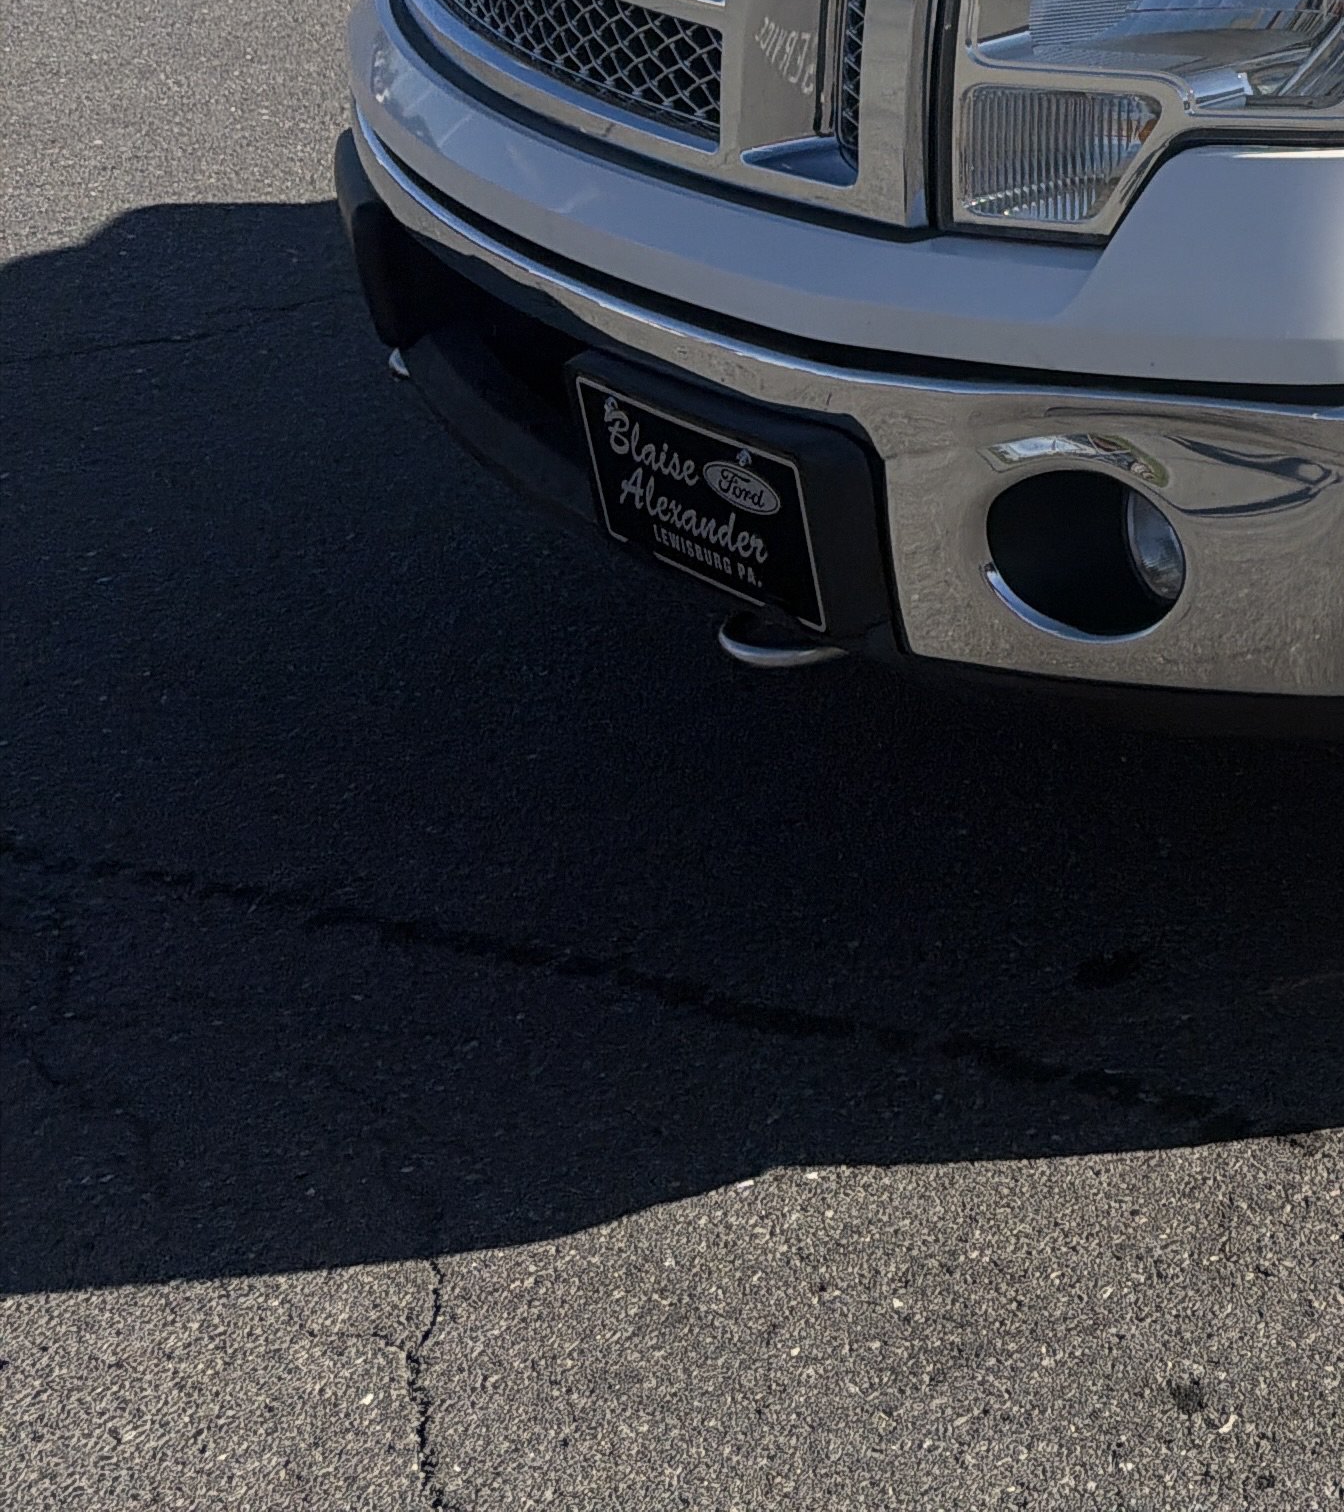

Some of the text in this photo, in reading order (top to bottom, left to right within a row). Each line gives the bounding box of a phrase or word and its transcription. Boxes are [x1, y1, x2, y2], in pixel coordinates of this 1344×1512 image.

[604, 409, 700, 487] Blaise
[619, 467, 769, 564] Alexander
[719, 469, 765, 509] Ford
[652, 524, 764, 589] LEWISBURG PA.
